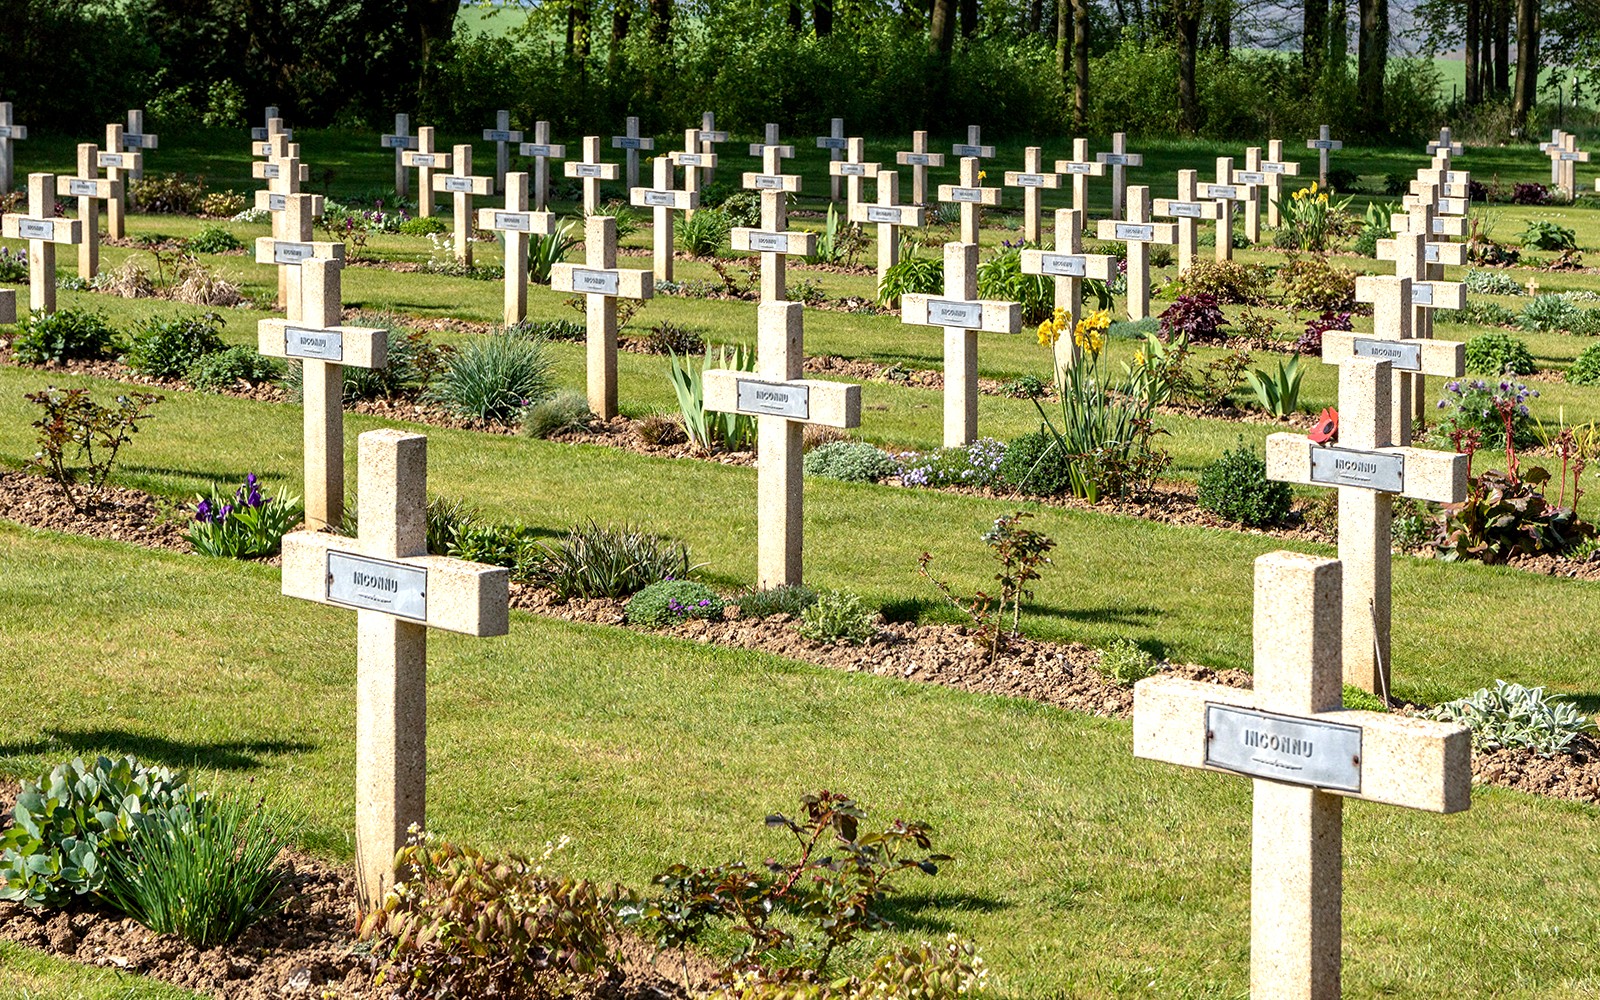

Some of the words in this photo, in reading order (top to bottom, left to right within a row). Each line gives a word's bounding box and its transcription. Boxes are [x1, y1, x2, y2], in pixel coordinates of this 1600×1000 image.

[1371, 347, 1402, 358] INCONNU
[756, 390, 789, 403] INCONNU
[1335, 459, 1377, 474] INCONNU
[353, 571, 398, 593] INCONNU
[1245, 729, 1314, 758] INCONNU
